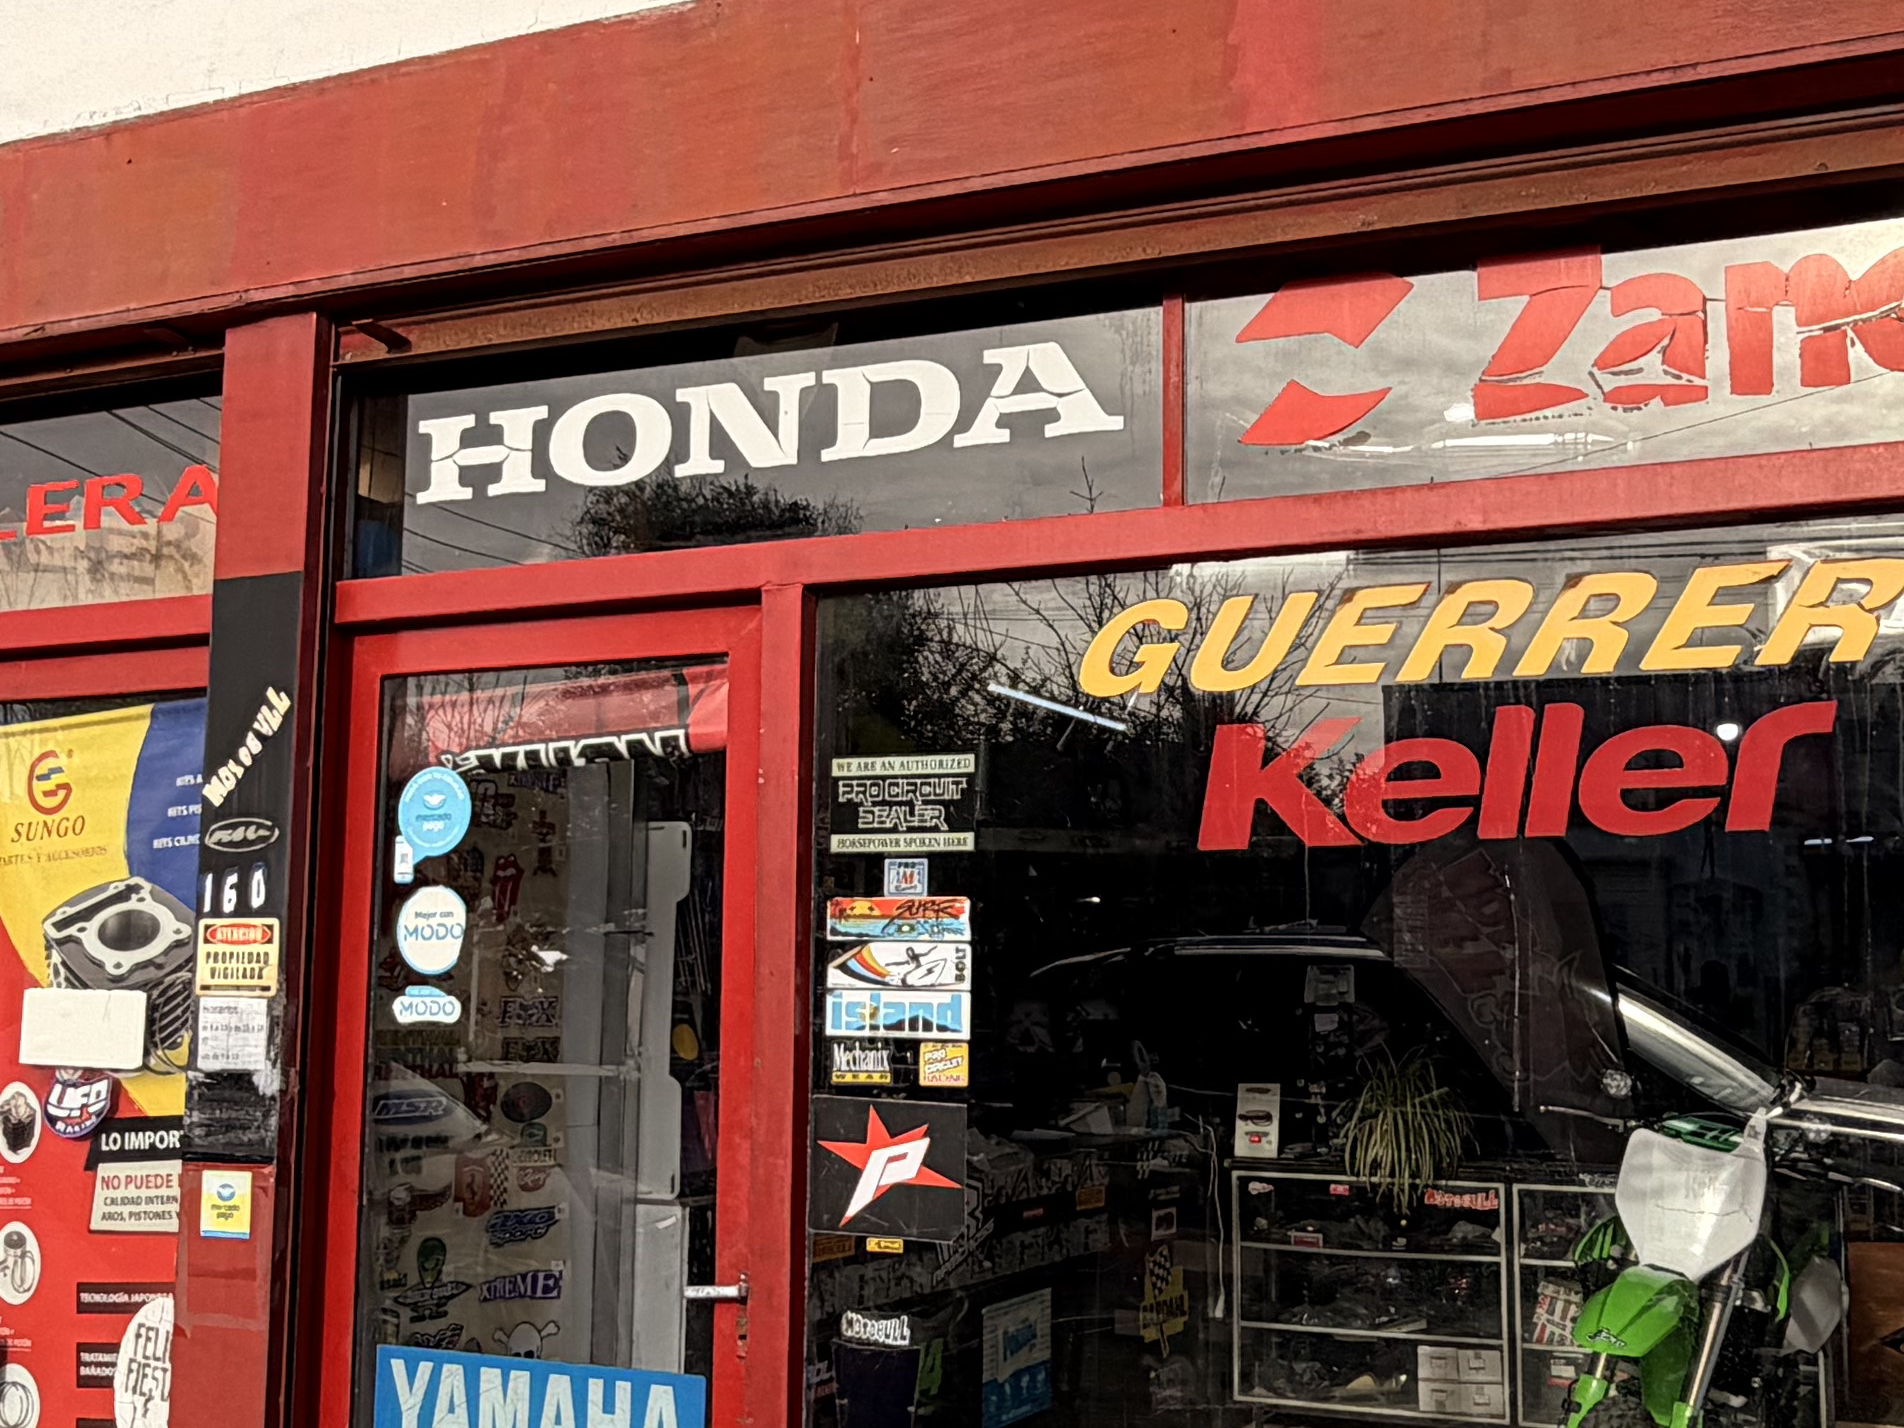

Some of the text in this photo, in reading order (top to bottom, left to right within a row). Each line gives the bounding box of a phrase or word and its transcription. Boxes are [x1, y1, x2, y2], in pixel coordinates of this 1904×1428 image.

[415, 340, 1124, 507] HONDA
[855, 760, 876, 773] ARE
[879, 761, 896, 772] AN
[897, 757, 971, 772] AUTHORIZED
[1195, 702, 1837, 852] Keller
[838, 777, 968, 805] PRO CIRCUIT
[10, 815, 86, 844] SUNGO
[858, 804, 949, 831] DEALER
[403, 922, 464, 942] MODO
[205, 951, 270, 965] PROPIEDAD
[954, 945, 967, 984] BOLT
[209, 966, 264, 980] VIGILADA
[399, 999, 457, 1017] MODO
[831, 992, 963, 1033] island
[832, 1042, 890, 1073] Mechanix
[48, 1079, 109, 1109] UFO
[101, 1130, 184, 1152] LO IMPOR
[101, 1172, 175, 1191] NO PUEDE
[128, 1209, 174, 1221] PISTONES
[479, 1270, 563, 1303] XTREME
